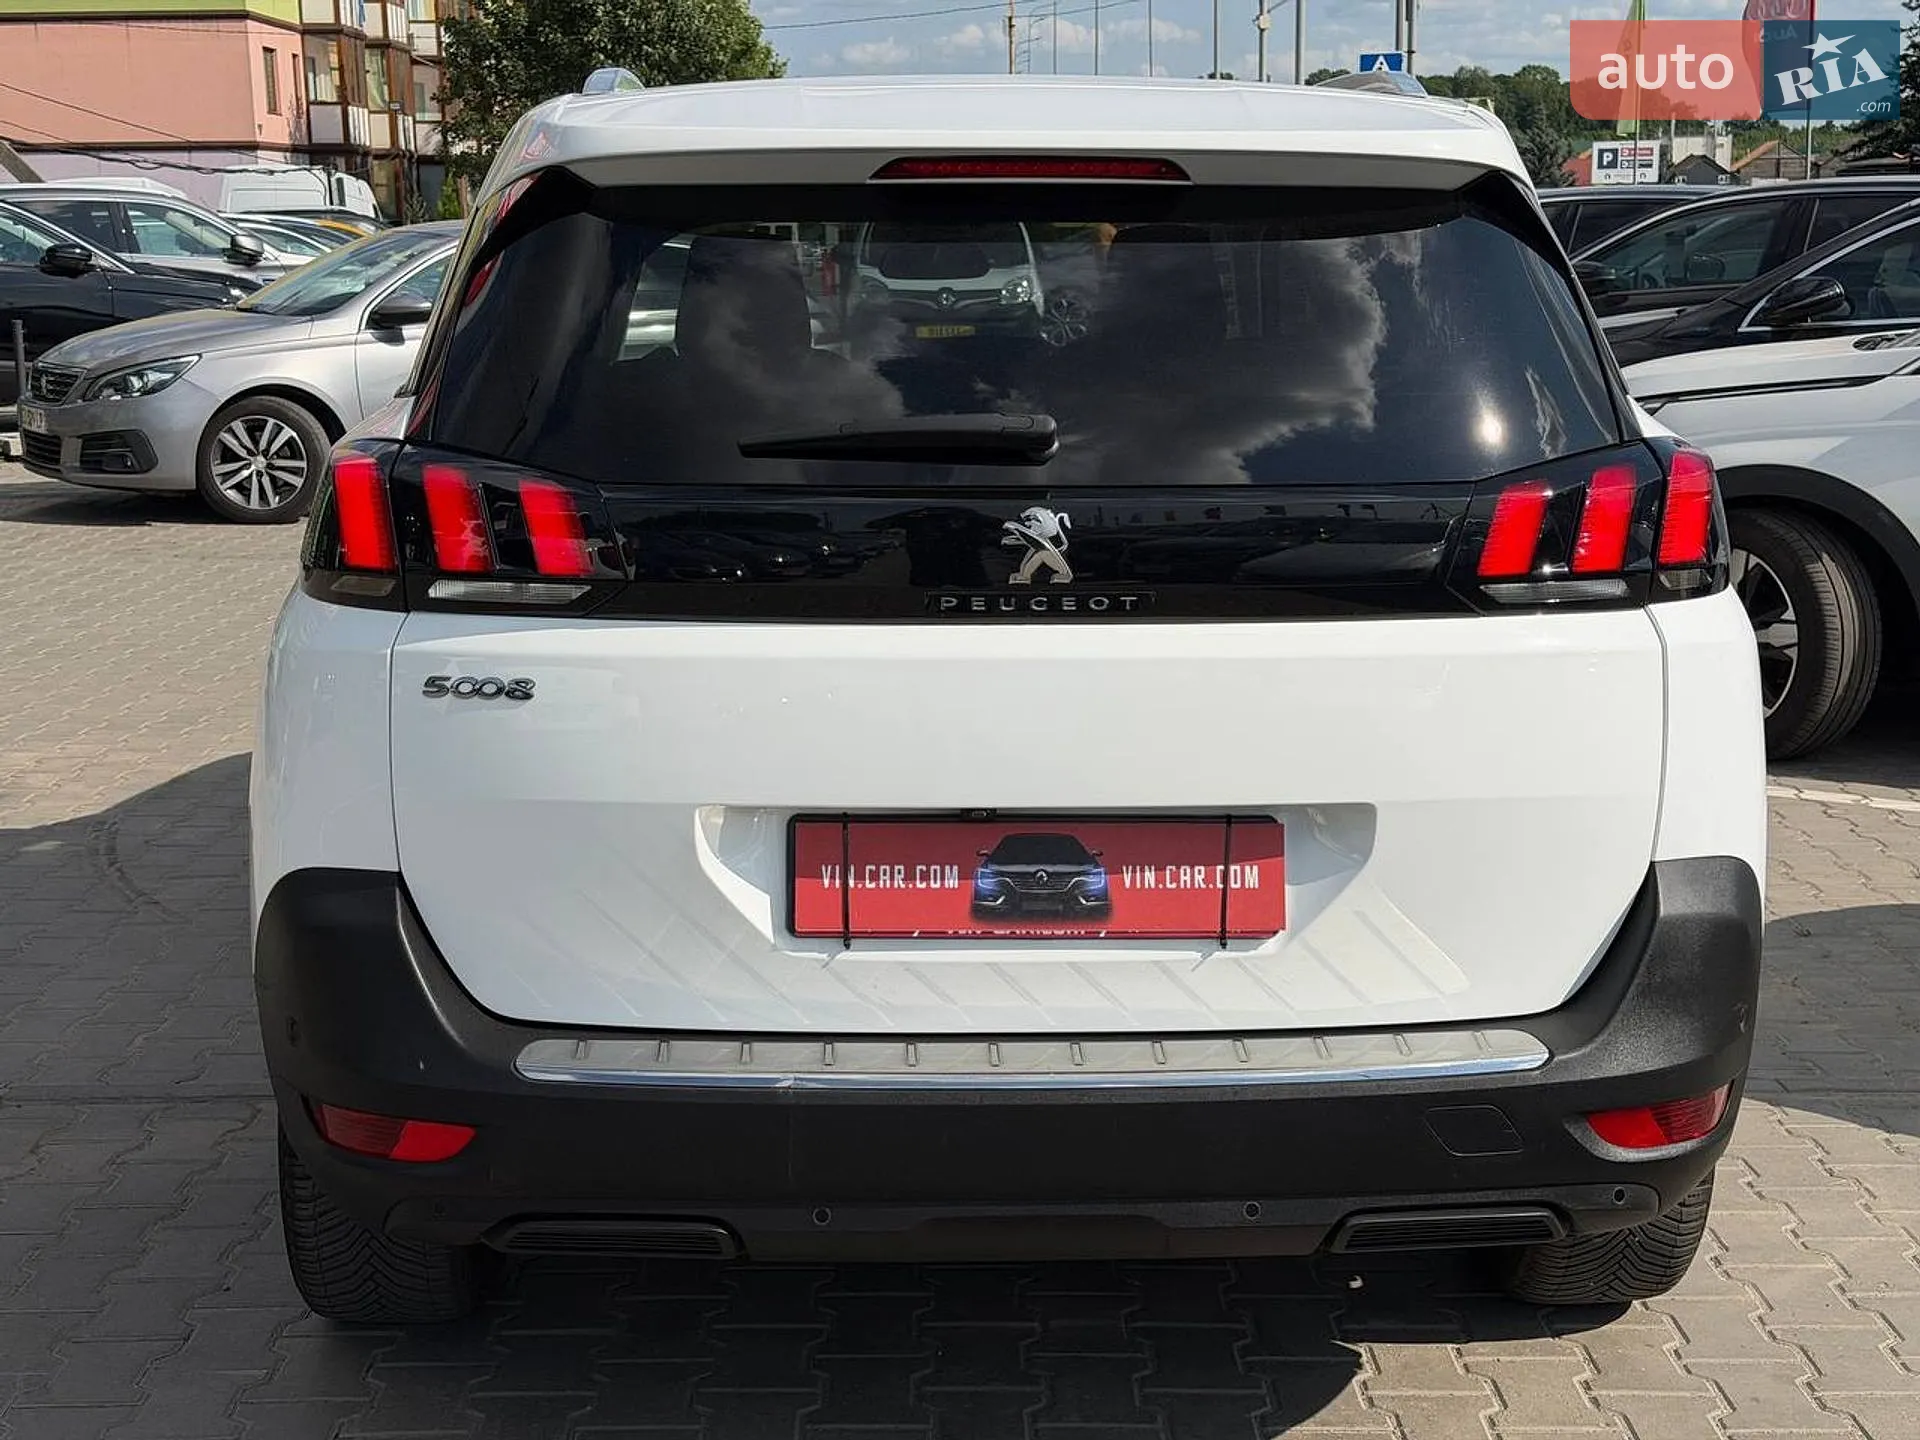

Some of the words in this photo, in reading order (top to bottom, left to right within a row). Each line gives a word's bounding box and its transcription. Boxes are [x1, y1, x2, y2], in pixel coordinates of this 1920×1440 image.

[1602, 152, 1614, 166] P
[940, 596, 1138, 611] PEUGEOT
[422, 676, 536, 700] 5008
[821, 864, 959, 889] VIN.CAR.COM
[1122, 864, 1259, 889] VIN.CAR.COM
